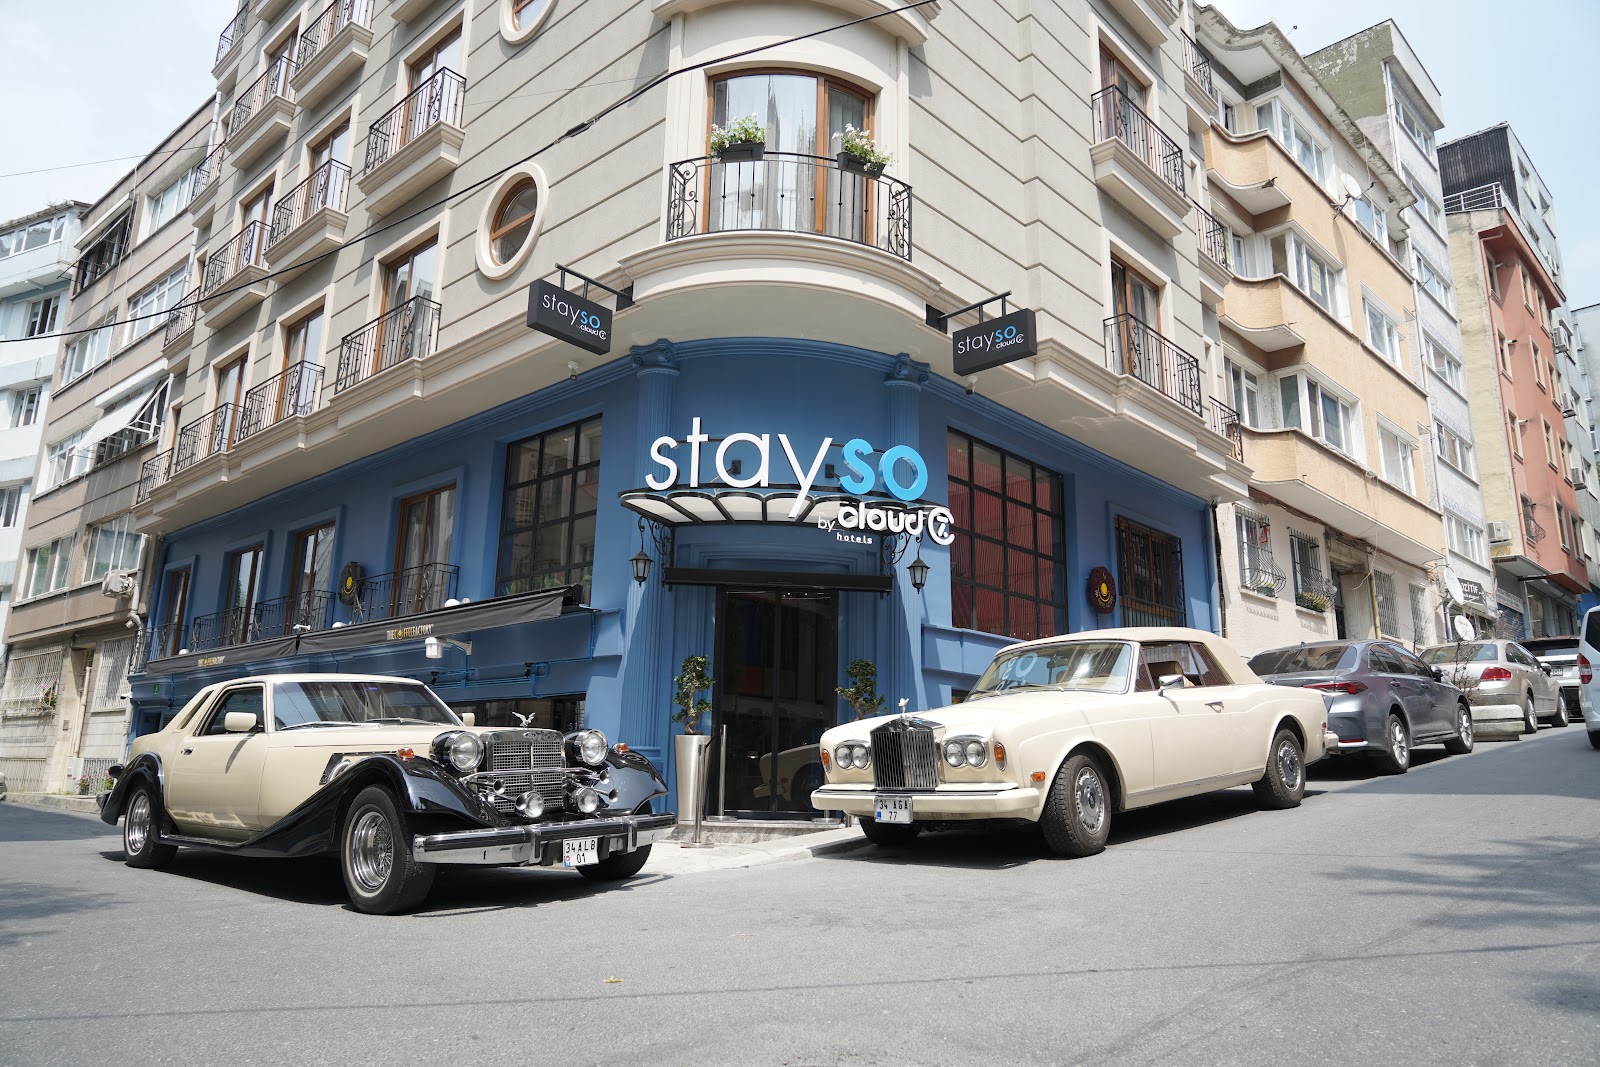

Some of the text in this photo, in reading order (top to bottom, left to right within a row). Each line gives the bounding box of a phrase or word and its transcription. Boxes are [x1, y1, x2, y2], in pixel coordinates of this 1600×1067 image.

[817, 516, 836, 532] by
[836, 532, 873, 545] hotels
[880, 800, 908, 810] 34 AGA
[889, 811, 898, 821] 77
[565, 839, 596, 853] 34 ALB
[576, 852, 586, 864] 01
